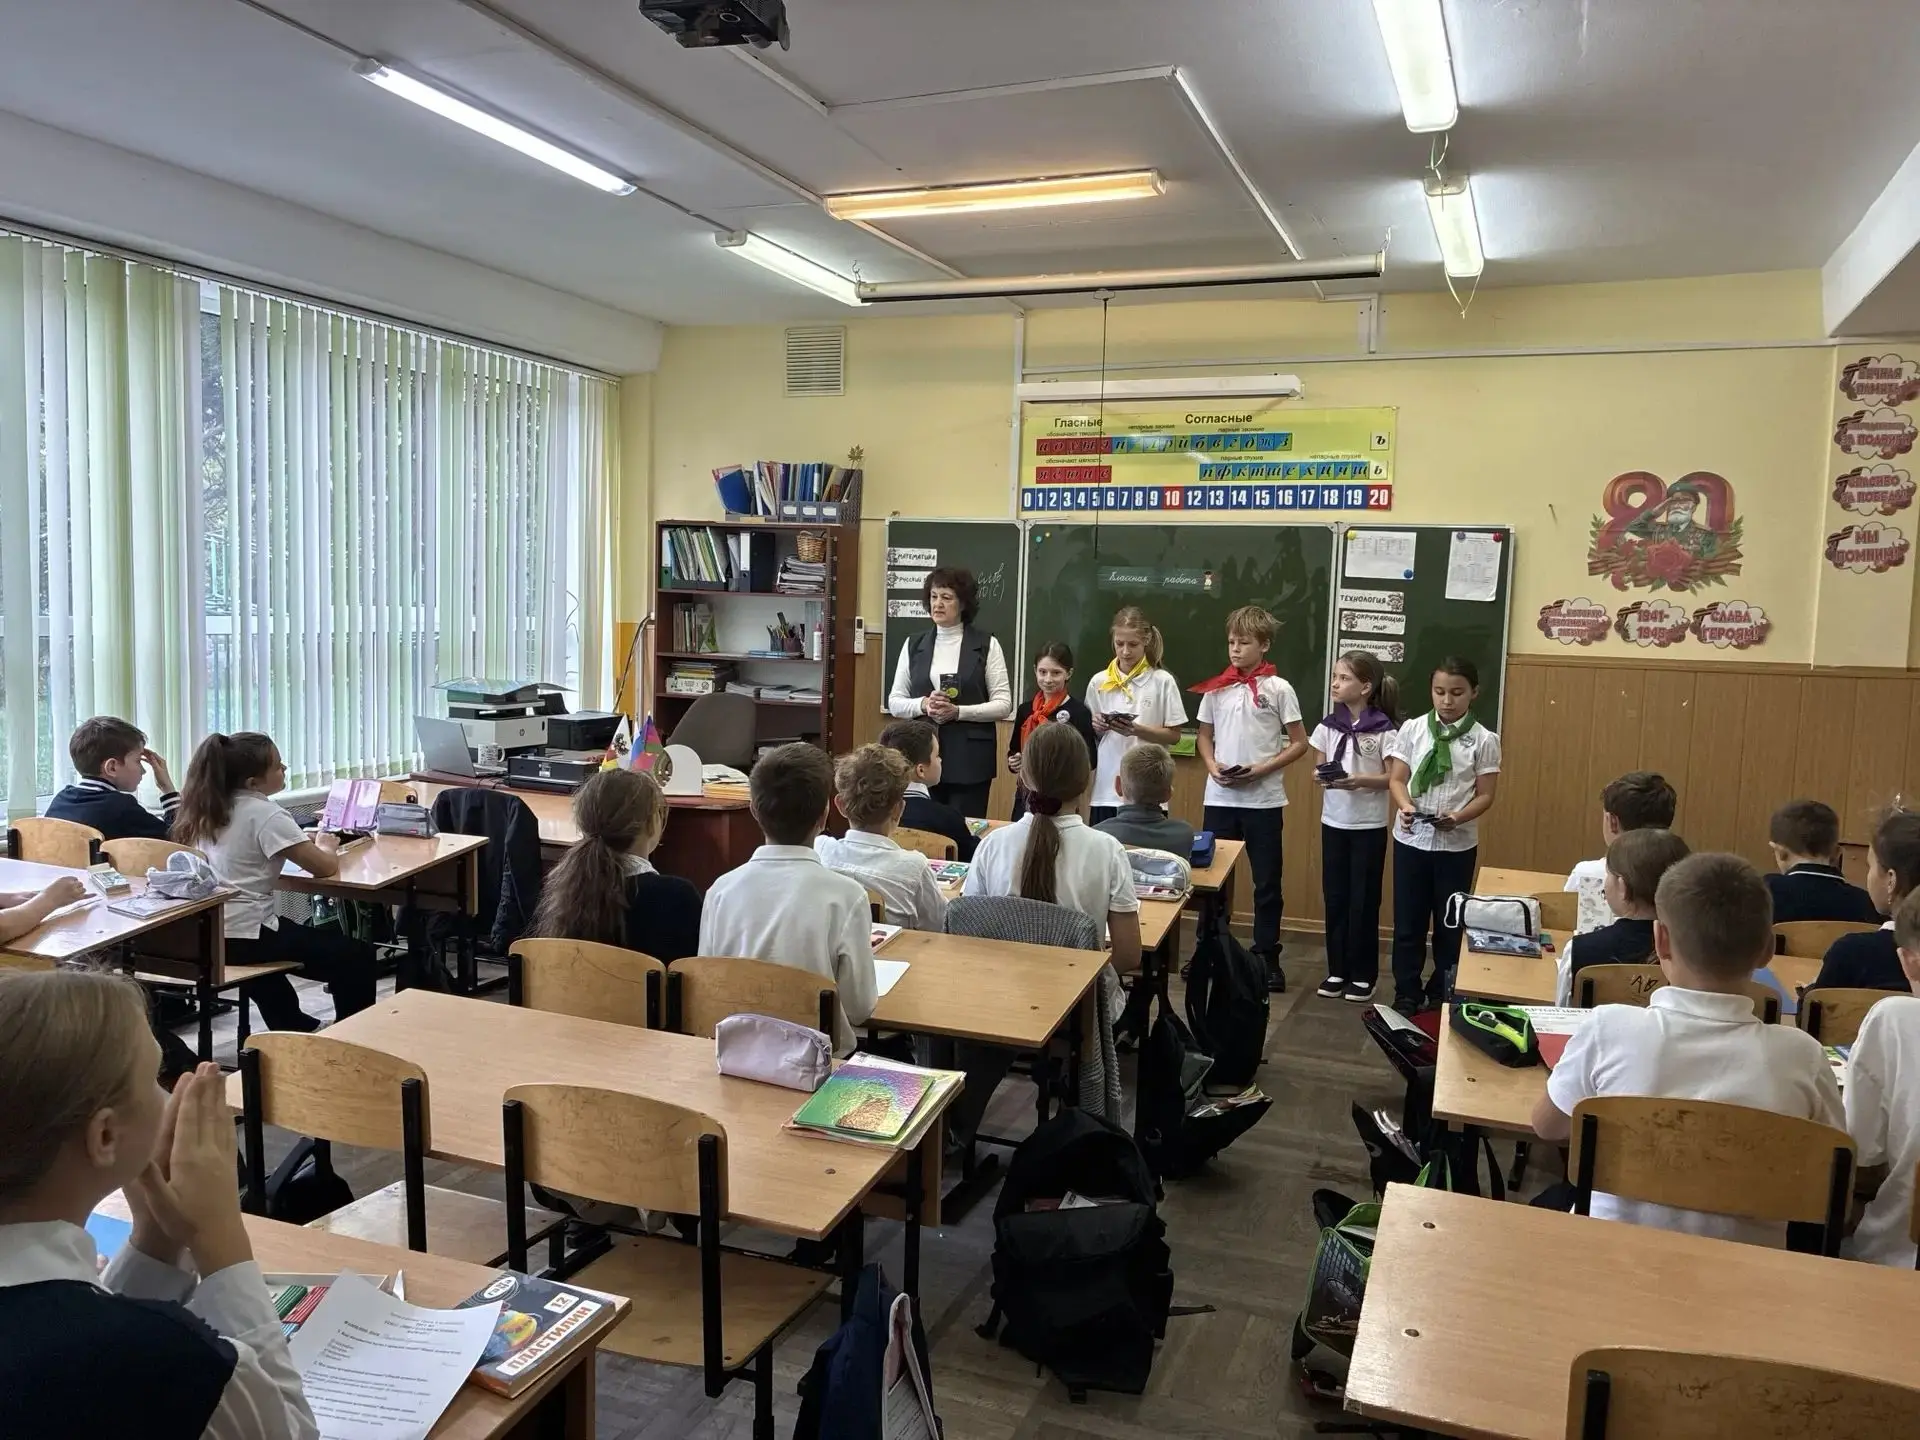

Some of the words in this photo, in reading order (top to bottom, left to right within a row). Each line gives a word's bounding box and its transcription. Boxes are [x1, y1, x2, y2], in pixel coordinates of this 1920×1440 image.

[1054, 418, 1103, 428] Гласные
[1185, 413, 1253, 424] Согласные
[1024, 492, 1031, 507] 0
[1038, 493, 1043, 507] 1
[1049, 492, 1057, 507] 2
[1063, 492, 1072, 506] 3
[1077, 492, 1086, 506] 4
[1092, 491, 1100, 506] 5
[1107, 491, 1114, 506] 6
[1121, 491, 1129, 506] 7
[1135, 491, 1143, 506] 8
[1150, 491, 1158, 506] 9
[1165, 491, 1180, 506] 10
[1187, 490, 1202, 505] 12
[1209, 490, 1224, 505] 13
[1231, 490, 1247, 505] 14
[1255, 490, 1270, 505] 15
[1277, 490, 1293, 505] 16
[1301, 490, 1315, 505] 17
[1323, 489, 1339, 505] 18
[1346, 489, 1362, 505] 19
[1369, 489, 1388, 505] 20
[1855, 530, 1879, 544] МЫ
[897, 553, 936, 561] МАТЕМАТИКА
[1109, 571, 1148, 582] Классная
[1162, 574, 1199, 586] работа
[1340, 594, 1387, 604] ТЕХНОЛОГИЯ
[1356, 613, 1405, 624] ОКРУЖАЮЩИЙ
[1637, 610, 1670, 622] 1941-
[1710, 610, 1752, 623] СЛАВА
[1637, 626, 1666, 639] 1945
[1702, 627, 1759, 642] ГЕРОЯМ!
[551, 1297, 569, 1307] 12
[507, 1306, 593, 1370] ПЛАСТИЛИН
